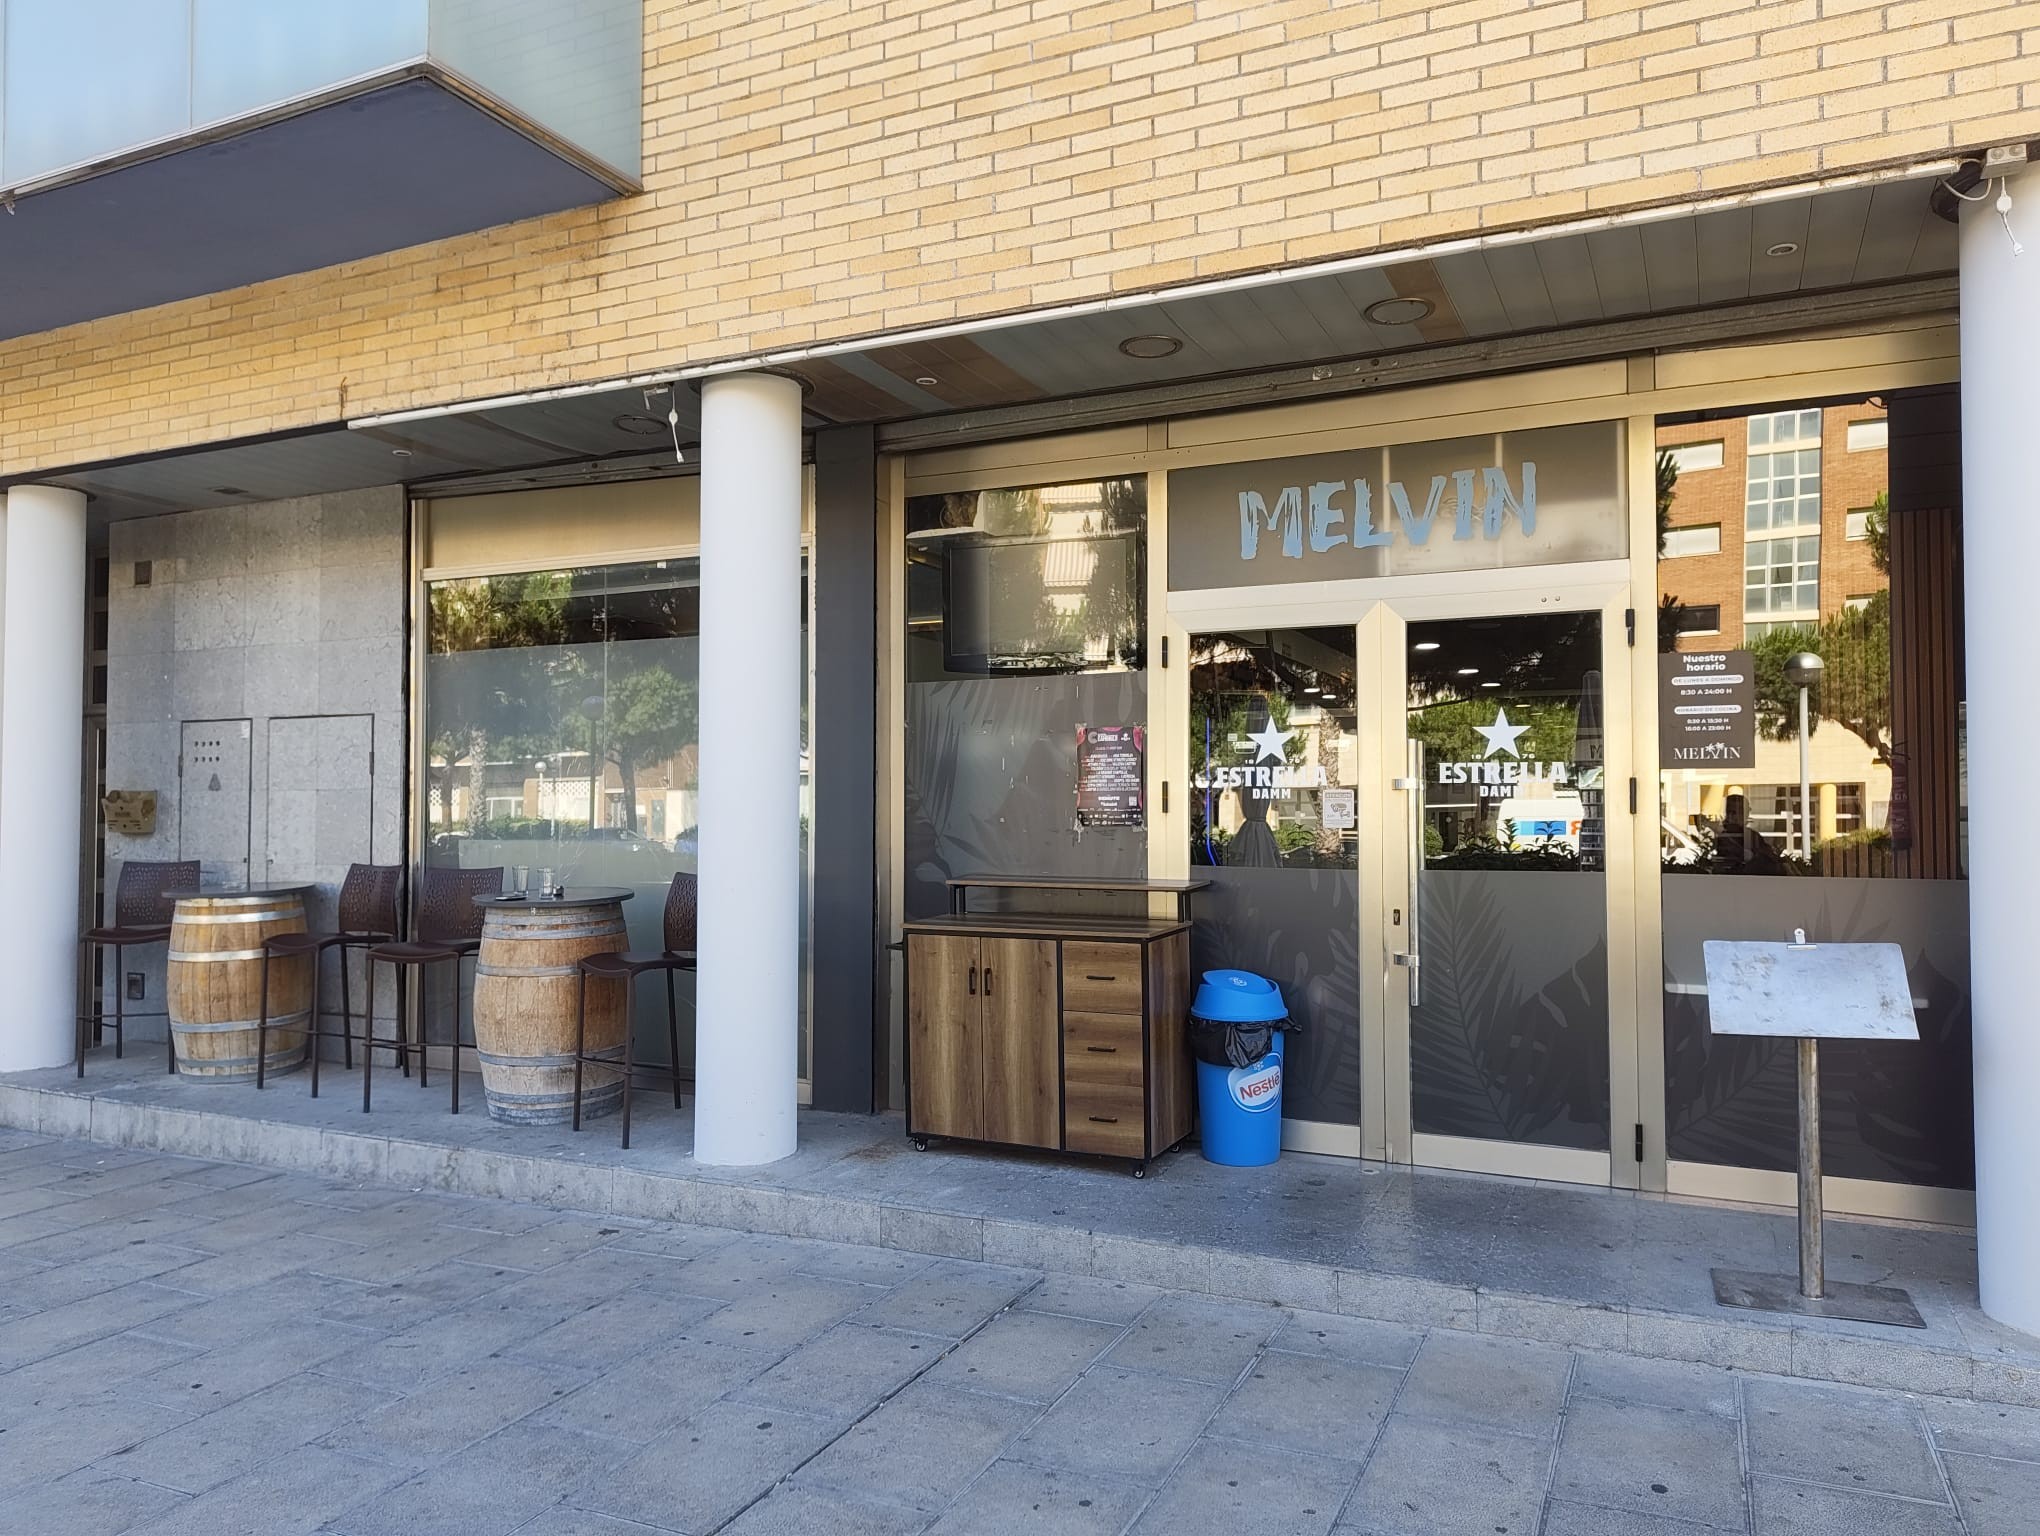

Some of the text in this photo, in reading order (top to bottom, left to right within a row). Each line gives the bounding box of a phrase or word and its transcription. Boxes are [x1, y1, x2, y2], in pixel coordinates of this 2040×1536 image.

[1238, 462, 1537, 560] MELVIN
[1683, 654, 1727, 663] Nuestro
[1686, 662, 1726, 671] horario
[1673, 744, 1742, 760] MELVIN
[1216, 766, 1328, 788] ESTRELLA
[1438, 761, 1569, 784] ESTRELLA
[1252, 788, 1291, 800] DAMM
[1239, 1071, 1281, 1101] Nestlé
